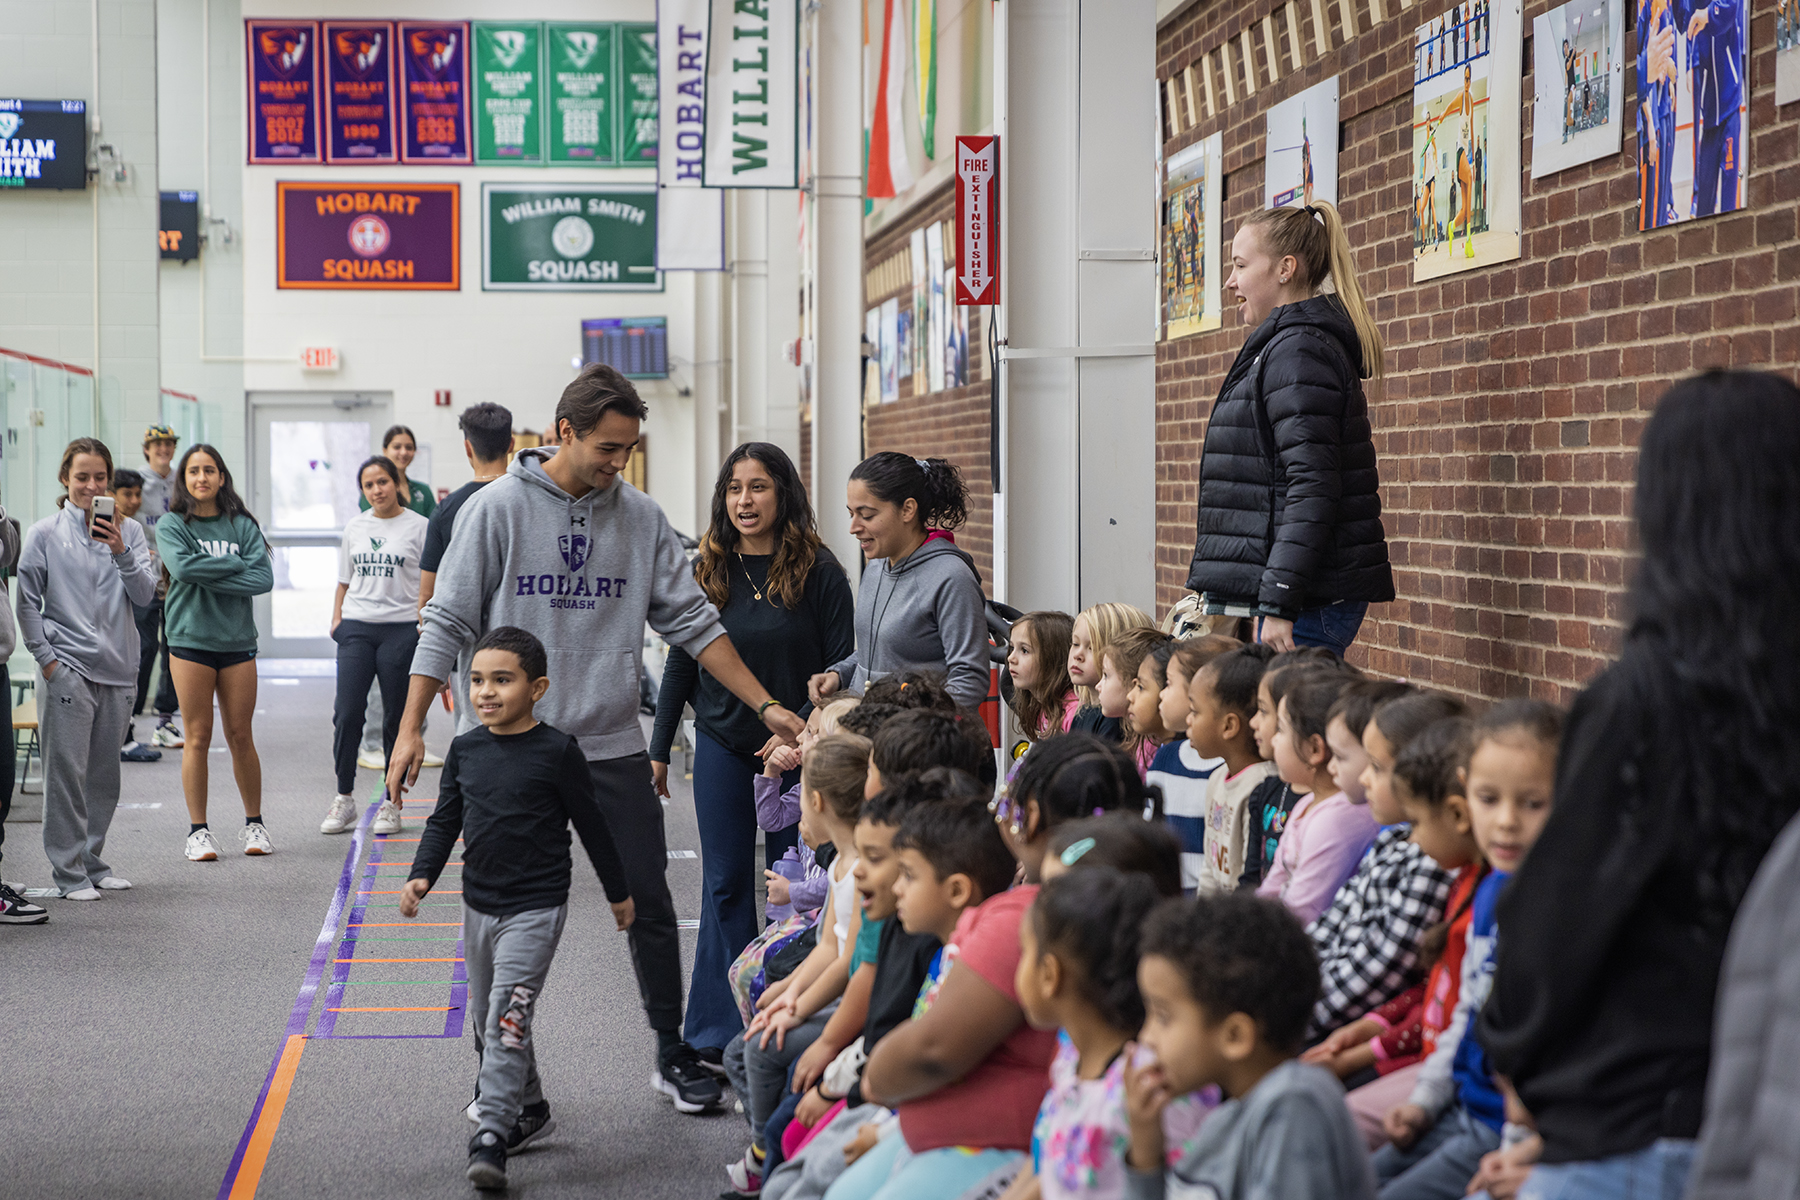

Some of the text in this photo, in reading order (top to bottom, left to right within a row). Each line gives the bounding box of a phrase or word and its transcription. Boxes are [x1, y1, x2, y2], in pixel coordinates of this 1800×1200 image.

[259, 81, 309, 93] HOBART
[335, 81, 385, 93] HOBART
[676, 24, 703, 181] HOBART
[964, 159, 988, 172] FIRE
[316, 192, 421, 216] HOBART
[501, 197, 646, 226] WILLIAM SMITH
[972, 175, 981, 287] EXTINGUISHER
[323, 259, 414, 280] SQUASH
[528, 260, 619, 281] SQUASH
[305, 347, 332, 367] EXIT
[357, 565, 394, 578] SMITH
[516, 575, 627, 598] HOBART
[550, 598, 595, 610] SQUASH
